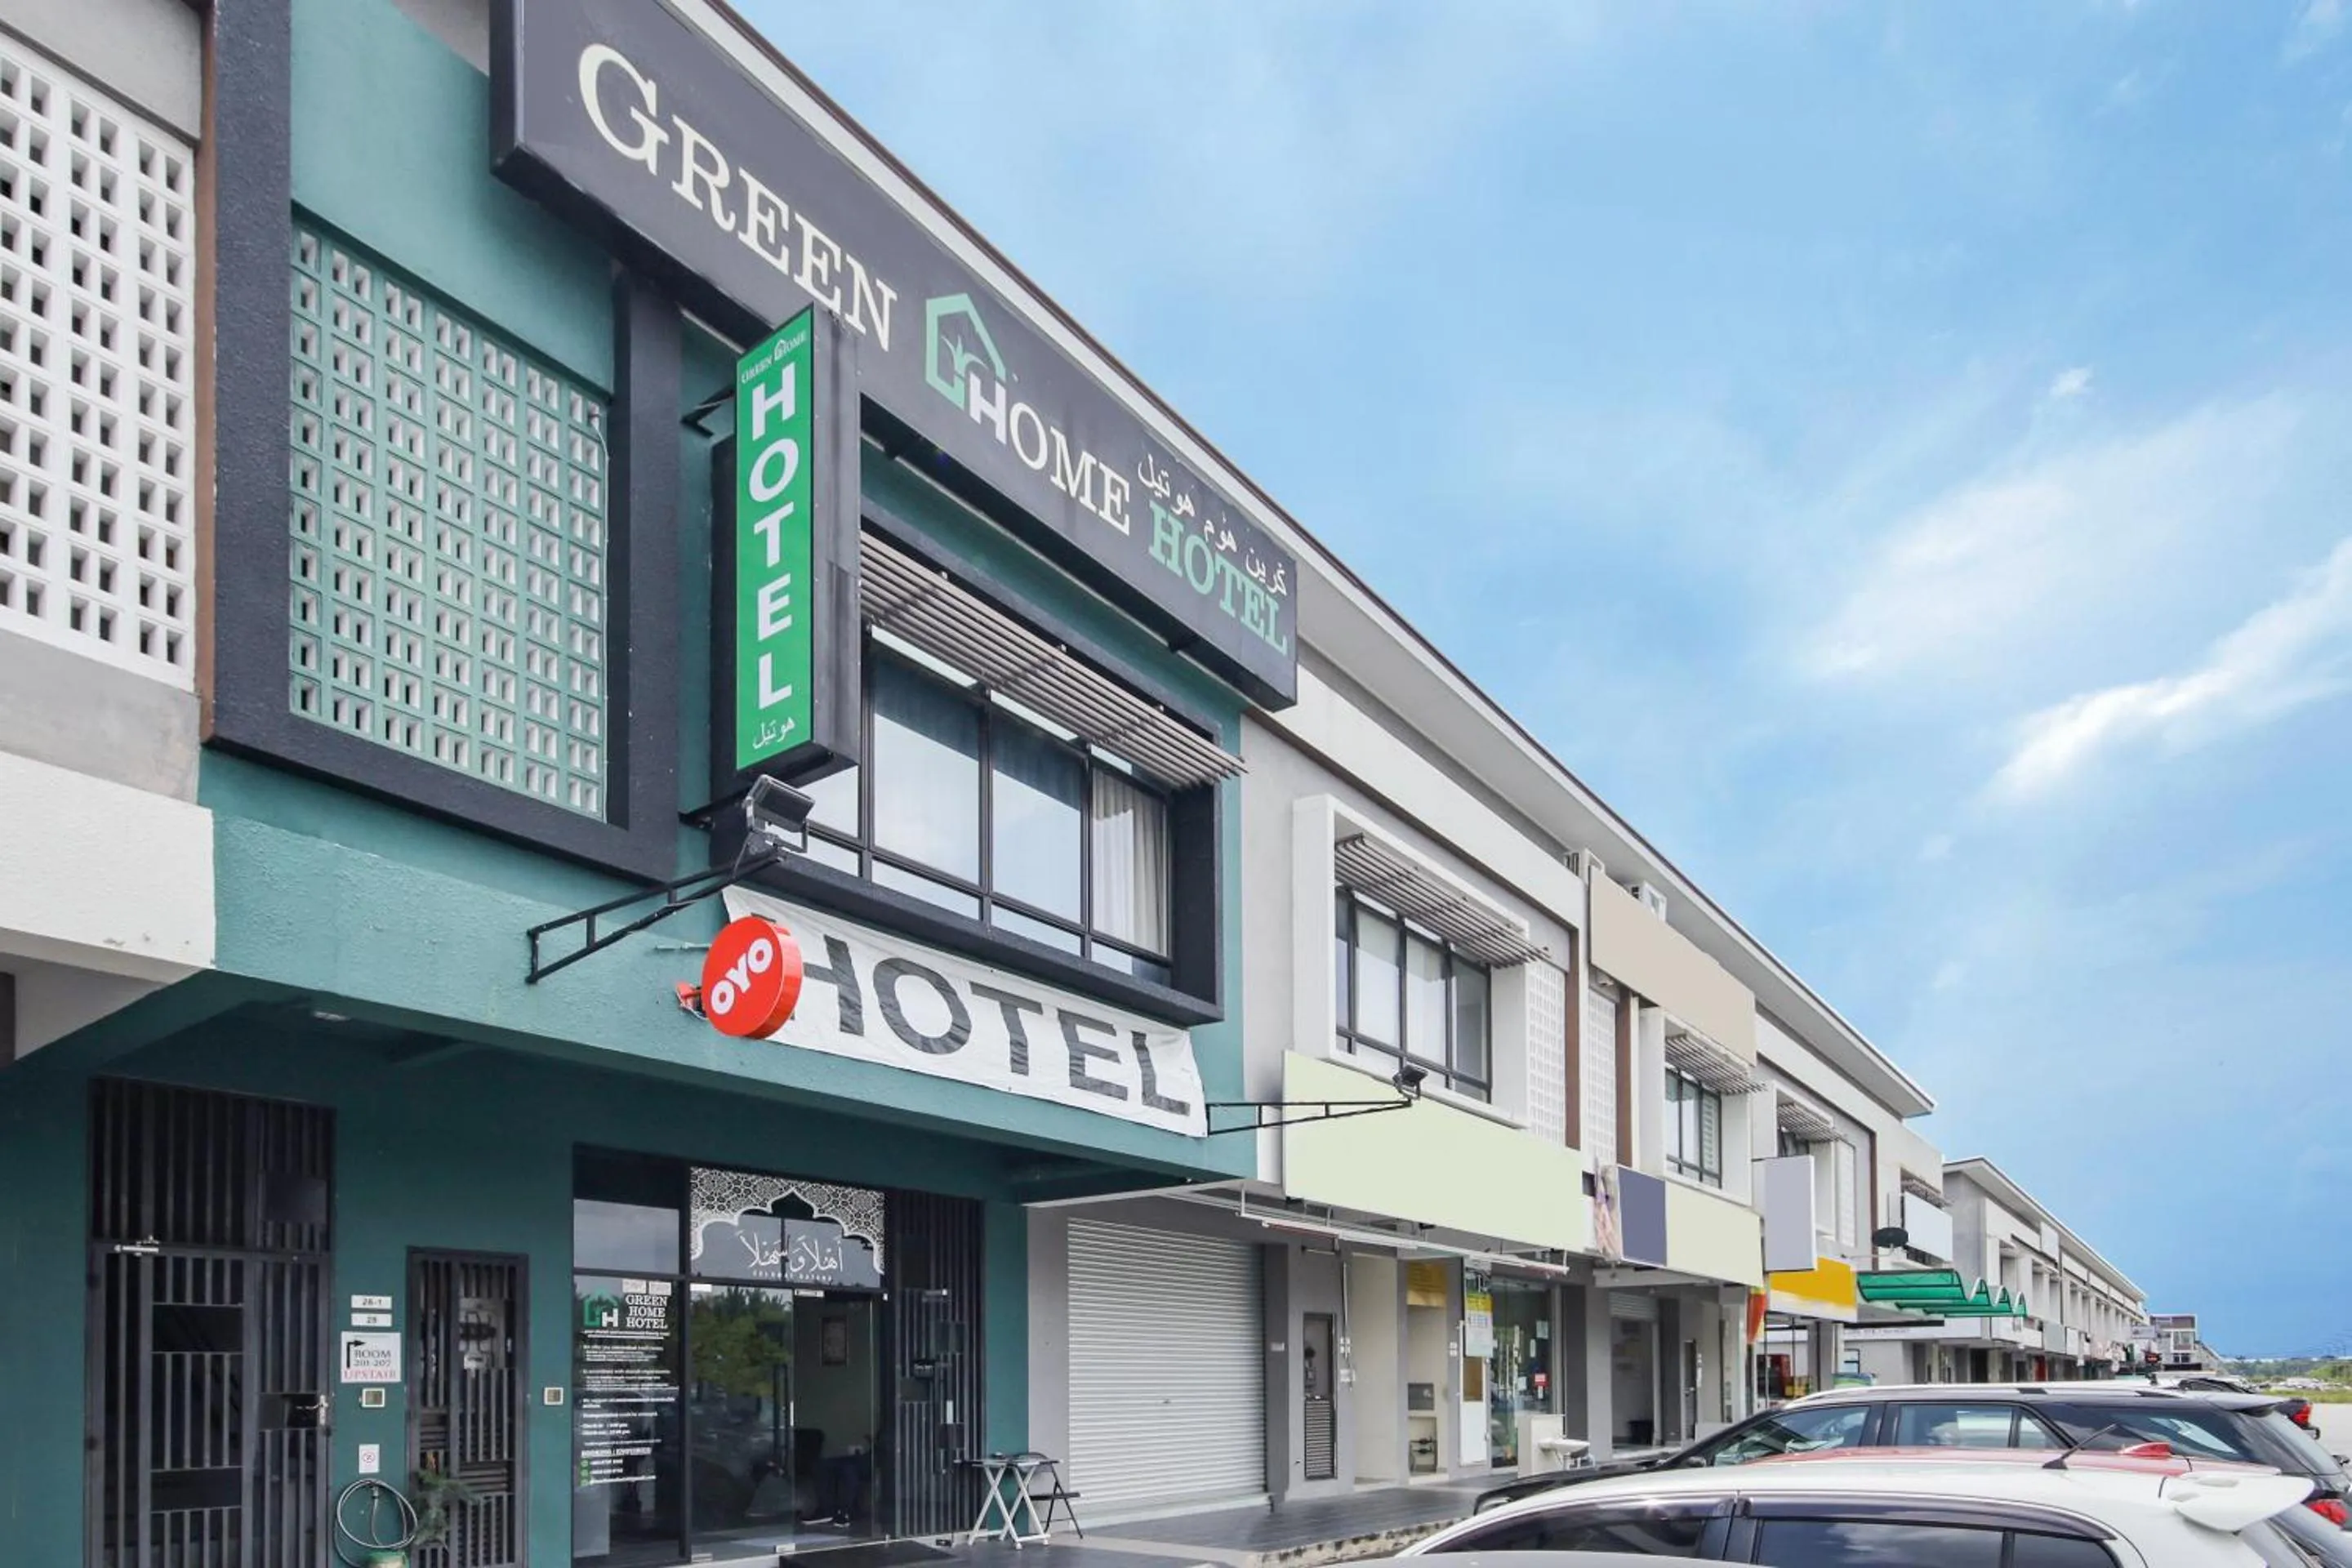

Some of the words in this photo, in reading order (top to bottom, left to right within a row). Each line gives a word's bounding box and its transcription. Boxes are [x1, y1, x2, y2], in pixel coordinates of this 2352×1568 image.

[579, 43, 897, 351] GREEN
[969, 371, 1130, 536] HOME
[1148, 500, 1287, 655] HOTEL
[749, 362, 800, 710] HOTEL
[711, 938, 774, 1015] OYO
[625, 1294, 667, 1307] GREEN
[626, 1316, 668, 1329] HOTEL
[628, 1306, 666, 1317] HOME
